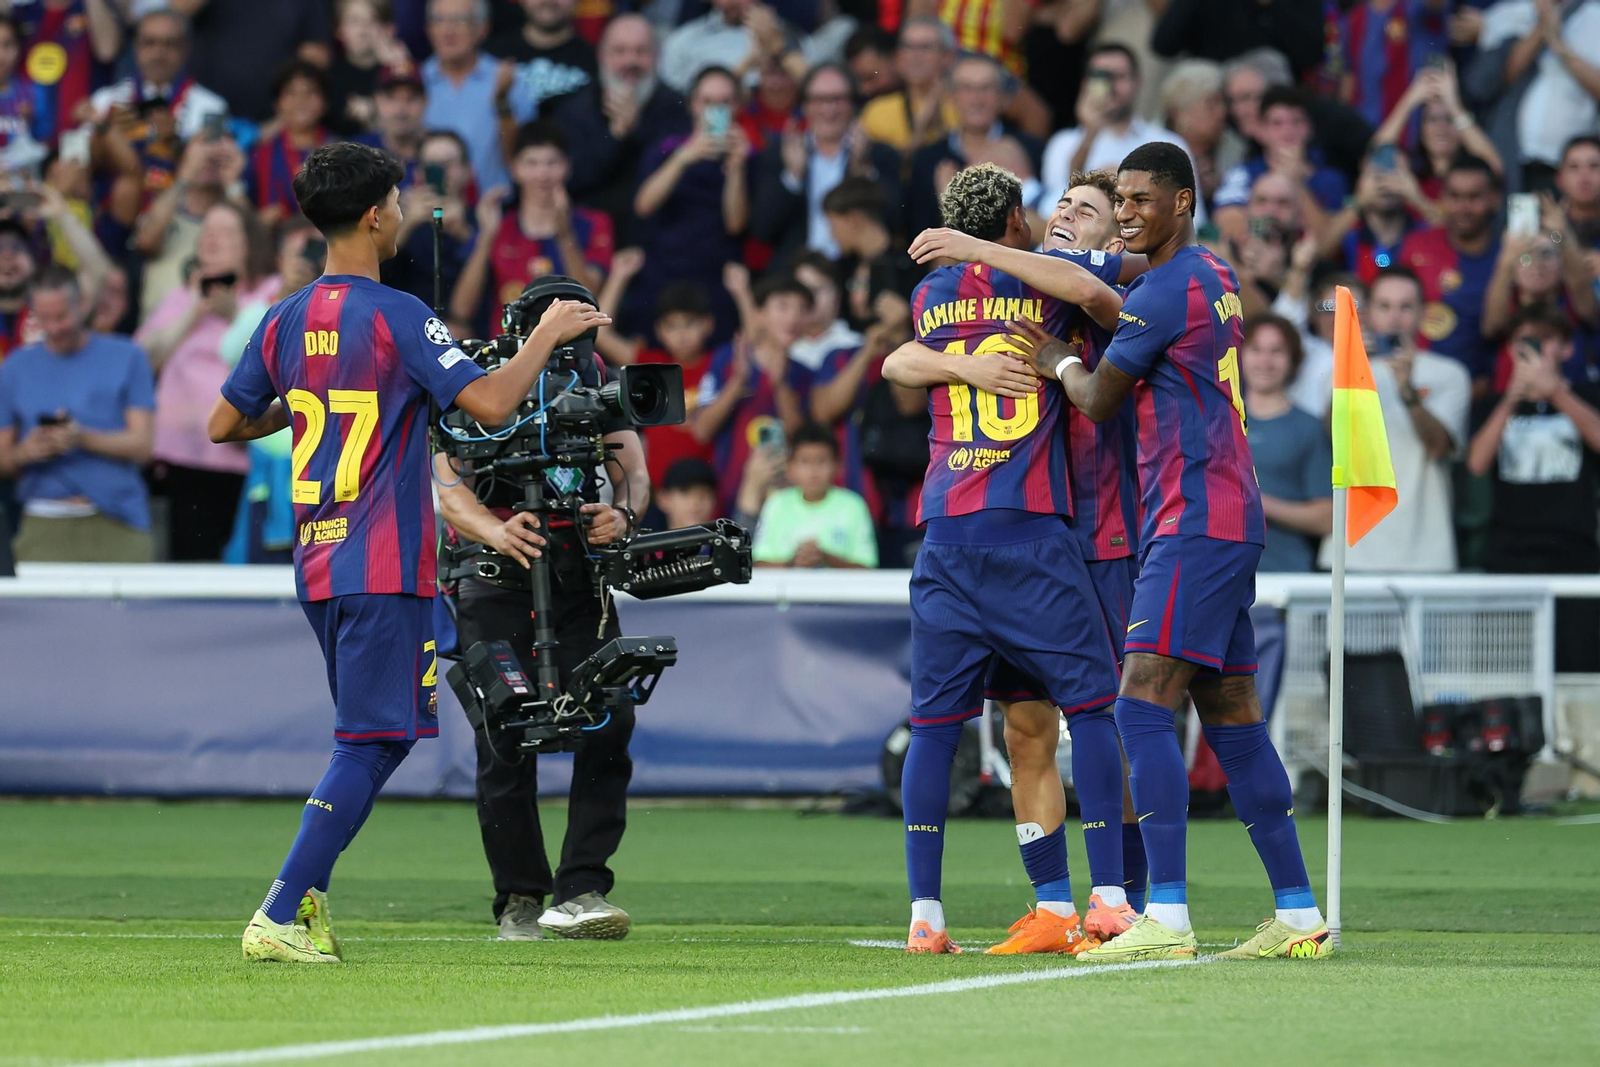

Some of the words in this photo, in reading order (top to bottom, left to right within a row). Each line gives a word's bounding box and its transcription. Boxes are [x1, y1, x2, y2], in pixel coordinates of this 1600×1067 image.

[917, 298, 977, 338] LAMINE
[982, 297, 1043, 323] YAMAL
[304, 330, 339, 357] DRO
[942, 333, 1040, 442] 10
[285, 388, 380, 505] 27
[312, 517, 348, 531] UNHCR
[313, 527, 347, 541] ACNUR
